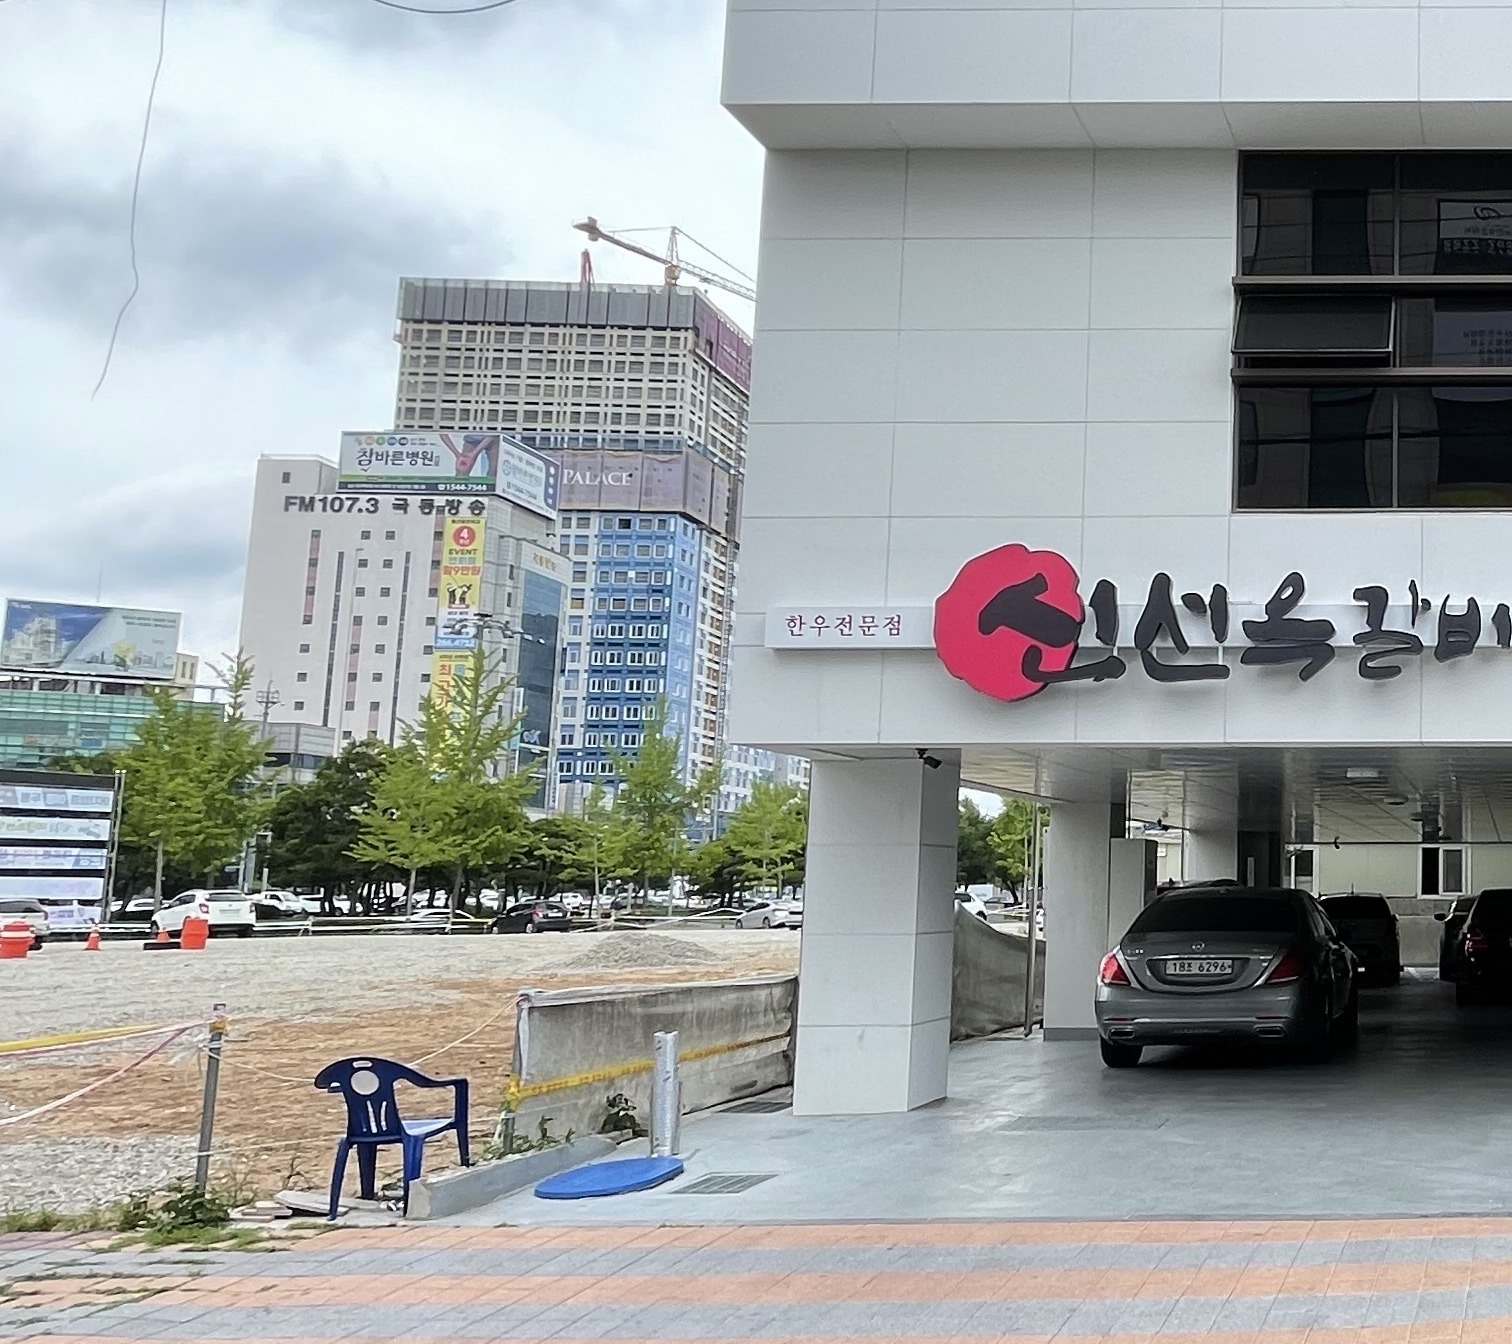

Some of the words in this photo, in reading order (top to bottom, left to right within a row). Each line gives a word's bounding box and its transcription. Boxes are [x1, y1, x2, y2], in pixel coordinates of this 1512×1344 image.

[562, 469, 632, 486] PALACE
[283, 496, 380, 514] FM107.3
[448, 548, 478, 556] EVENT
[785, 614, 902, 637] 한우전문점
[1198, 961, 1227, 972] 6296
